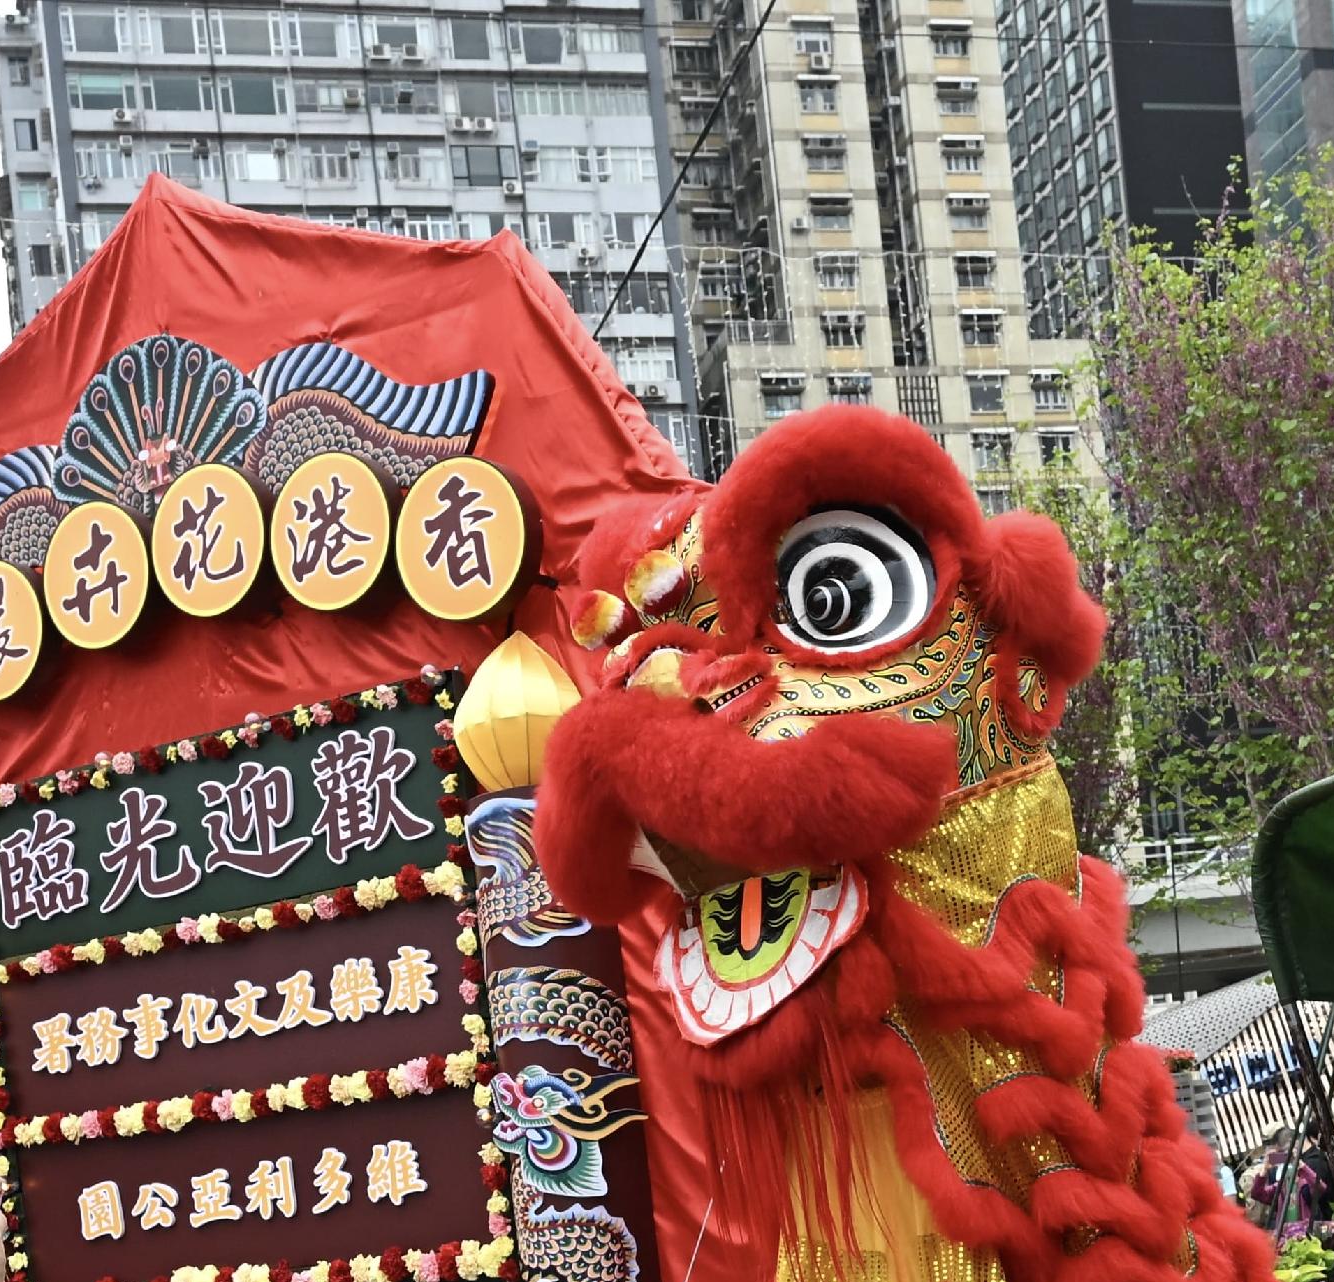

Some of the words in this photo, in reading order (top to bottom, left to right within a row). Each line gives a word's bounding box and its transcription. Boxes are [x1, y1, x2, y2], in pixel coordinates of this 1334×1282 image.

[31, 945, 438, 1075] 康樂及文化事務署
[77, 1139, 427, 1241] 維多利亞公園
